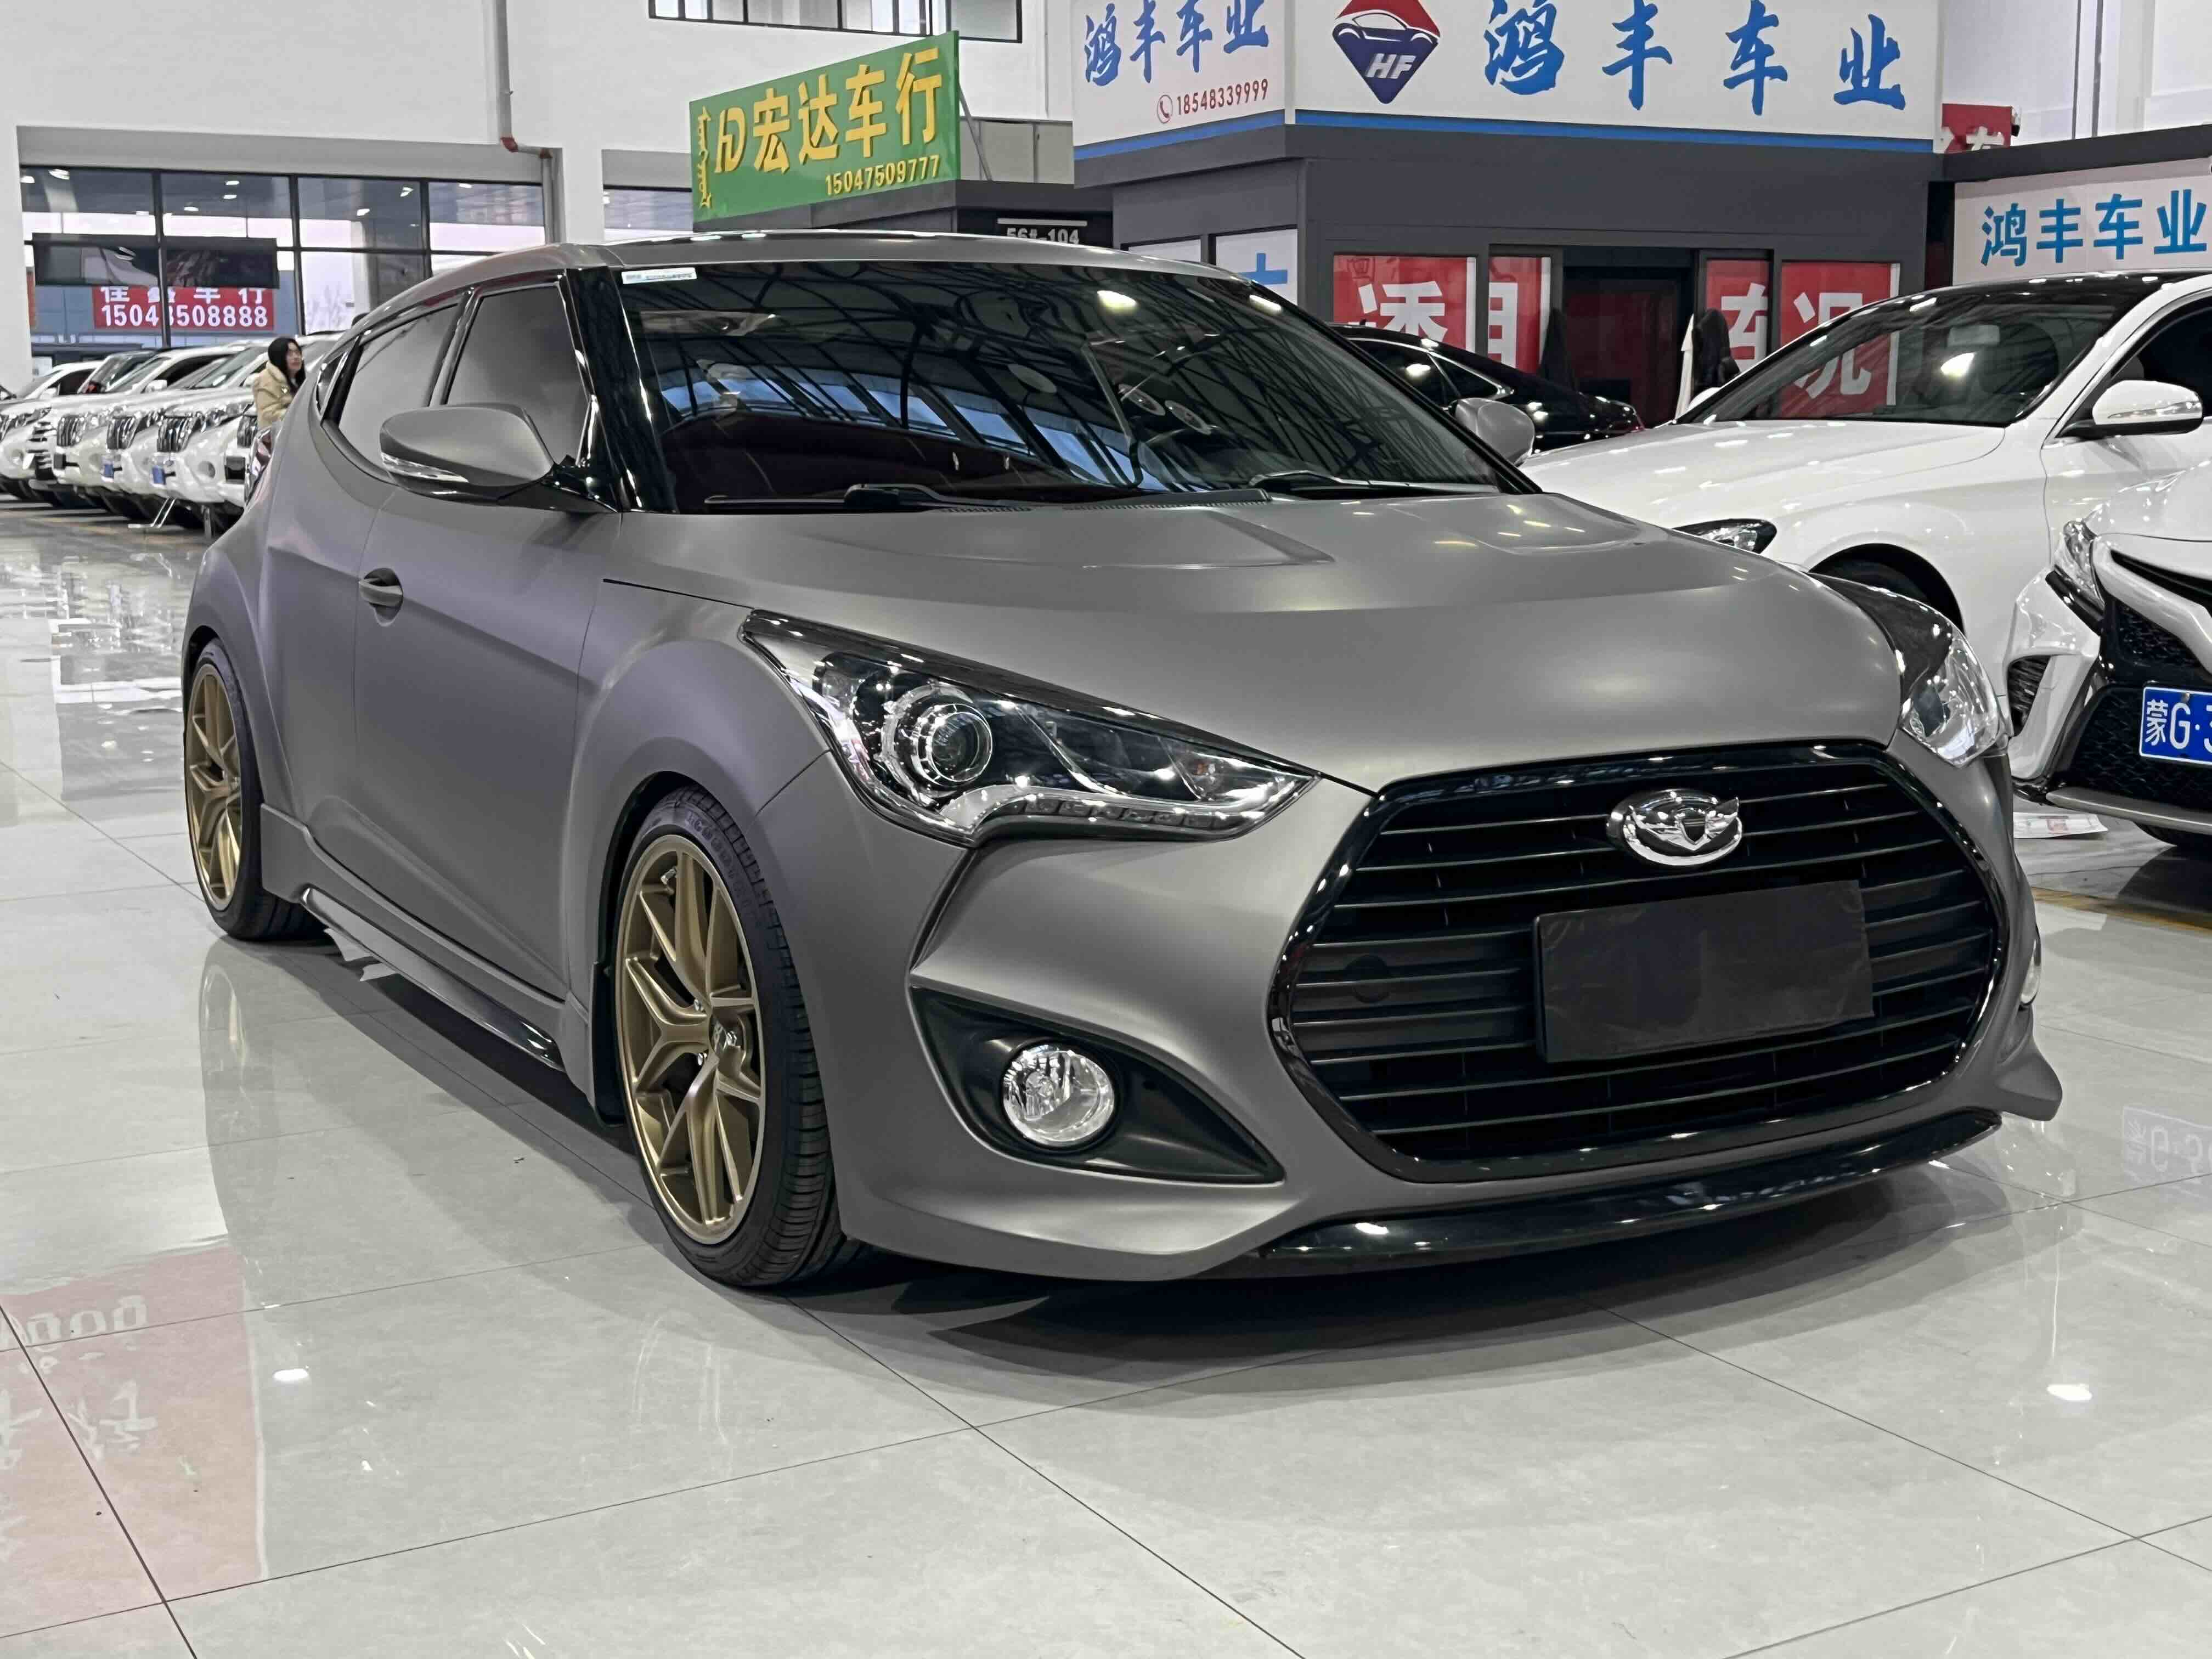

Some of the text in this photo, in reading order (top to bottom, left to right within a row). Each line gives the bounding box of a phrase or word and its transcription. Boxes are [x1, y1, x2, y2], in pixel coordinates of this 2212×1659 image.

[1084, 0, 1268, 86] 鸿丰车业
[1365, 53, 1417, 79] HF
[1484, 0, 1905, 116] 鸿丰车业
[752, 47, 943, 175] 宏达车行
[1177, 79, 1268, 115] 18548339999
[825, 154, 940, 196] 15047509777
[1981, 189, 2207, 266] 鸿丰车业
[2145, 699, 2212, 754] 蒙G·
